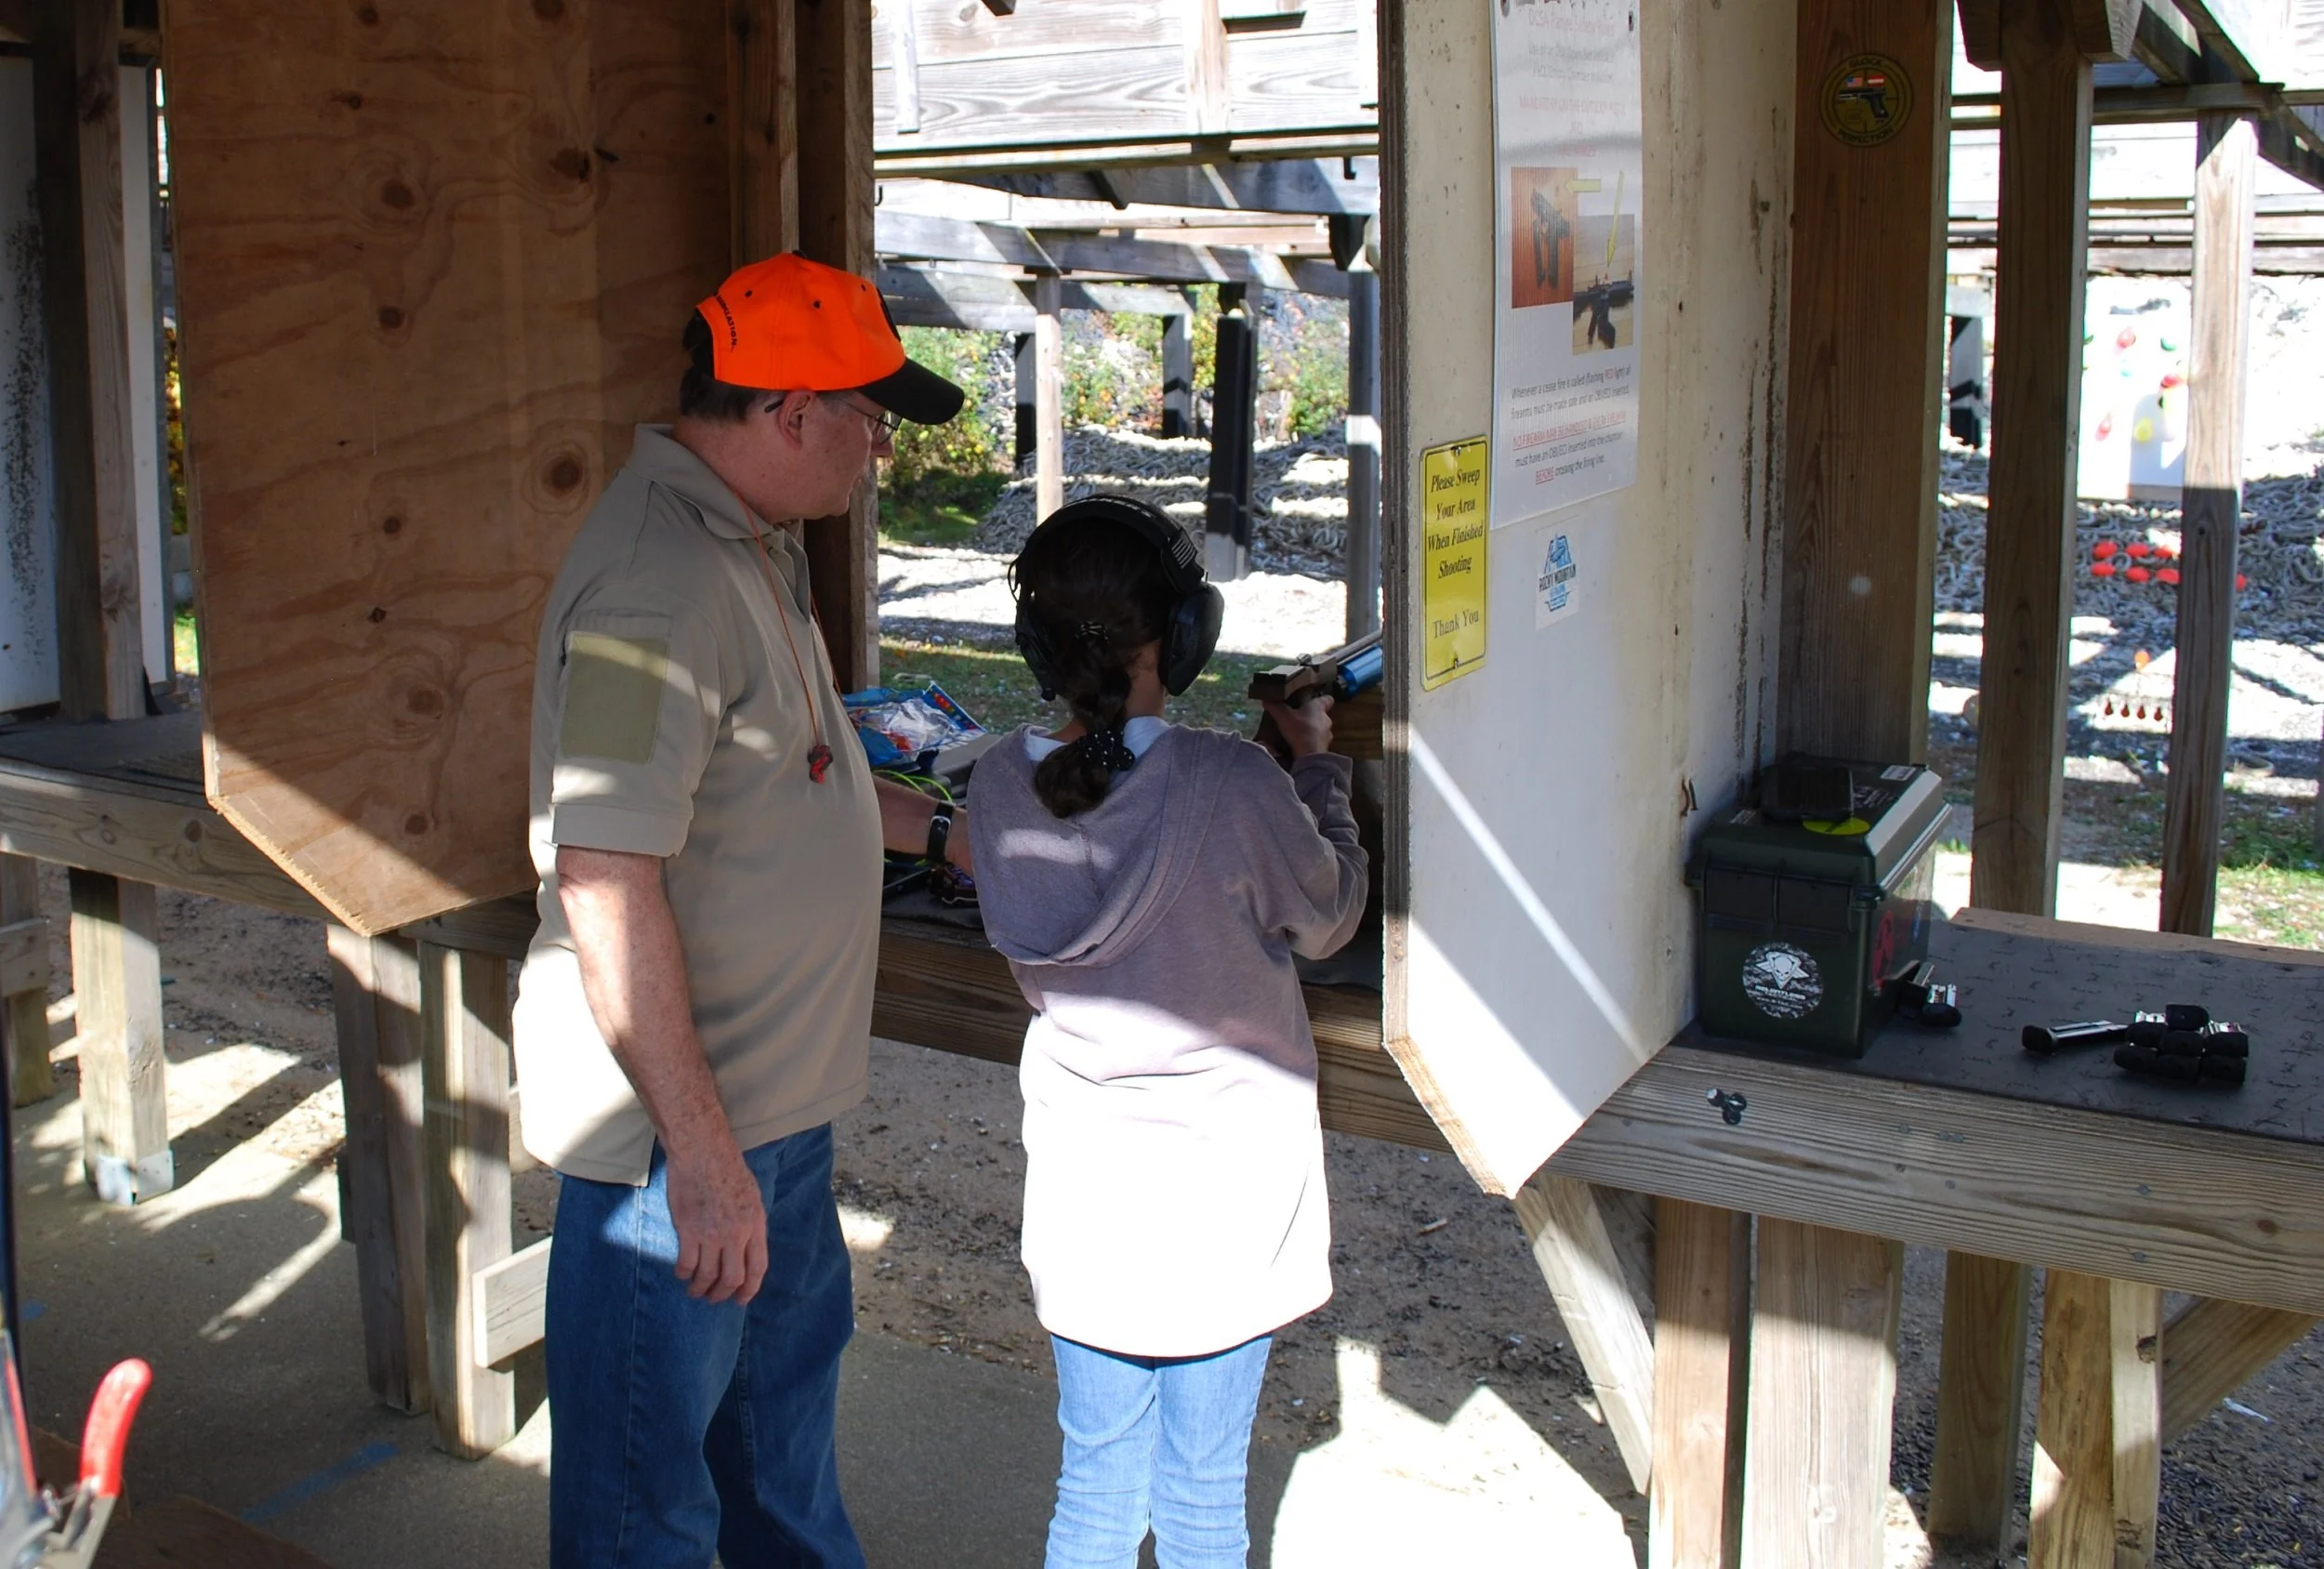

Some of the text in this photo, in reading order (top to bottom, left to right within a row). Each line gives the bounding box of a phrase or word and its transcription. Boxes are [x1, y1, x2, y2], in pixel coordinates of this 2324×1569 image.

[1849, 58, 1882, 68] GLOCK
[1837, 126, 1894, 143] PERFECTION
[1512, 386, 1537, 399] Whenever
[1543, 383, 1556, 393] cease
[1557, 378, 1565, 389] fire
[1571, 375, 1585, 388] called
[1604, 368, 1615, 380] RED
[1512, 407, 1532, 420] firearms
[1534, 403, 1545, 415] must
[1553, 399, 1567, 410] made
[1568, 397, 1578, 406] safe
[1513, 435, 1522, 448] NO
[1523, 429, 1545, 445] FIREARM
[1563, 419, 1587, 437] HANDLED
[1515, 457, 1527, 468] must
[1528, 453, 1541, 464] have
[1567, 440, 1587, 454] inserted
[1431, 468, 1480, 492] Please Sweep
[1536, 467, 1554, 482] BEFORE
[1555, 463, 1574, 476] crossing
[1584, 456, 1595, 468] firing
[1436, 497, 1475, 521] Your Area
[1428, 521, 1483, 551] When Finished
[1438, 556, 1472, 579] Shooting
[1538, 575, 1553, 592] ROCKY
[1554, 564, 1577, 586] MOUNTAIN
[1433, 609, 1479, 639] Thank You
